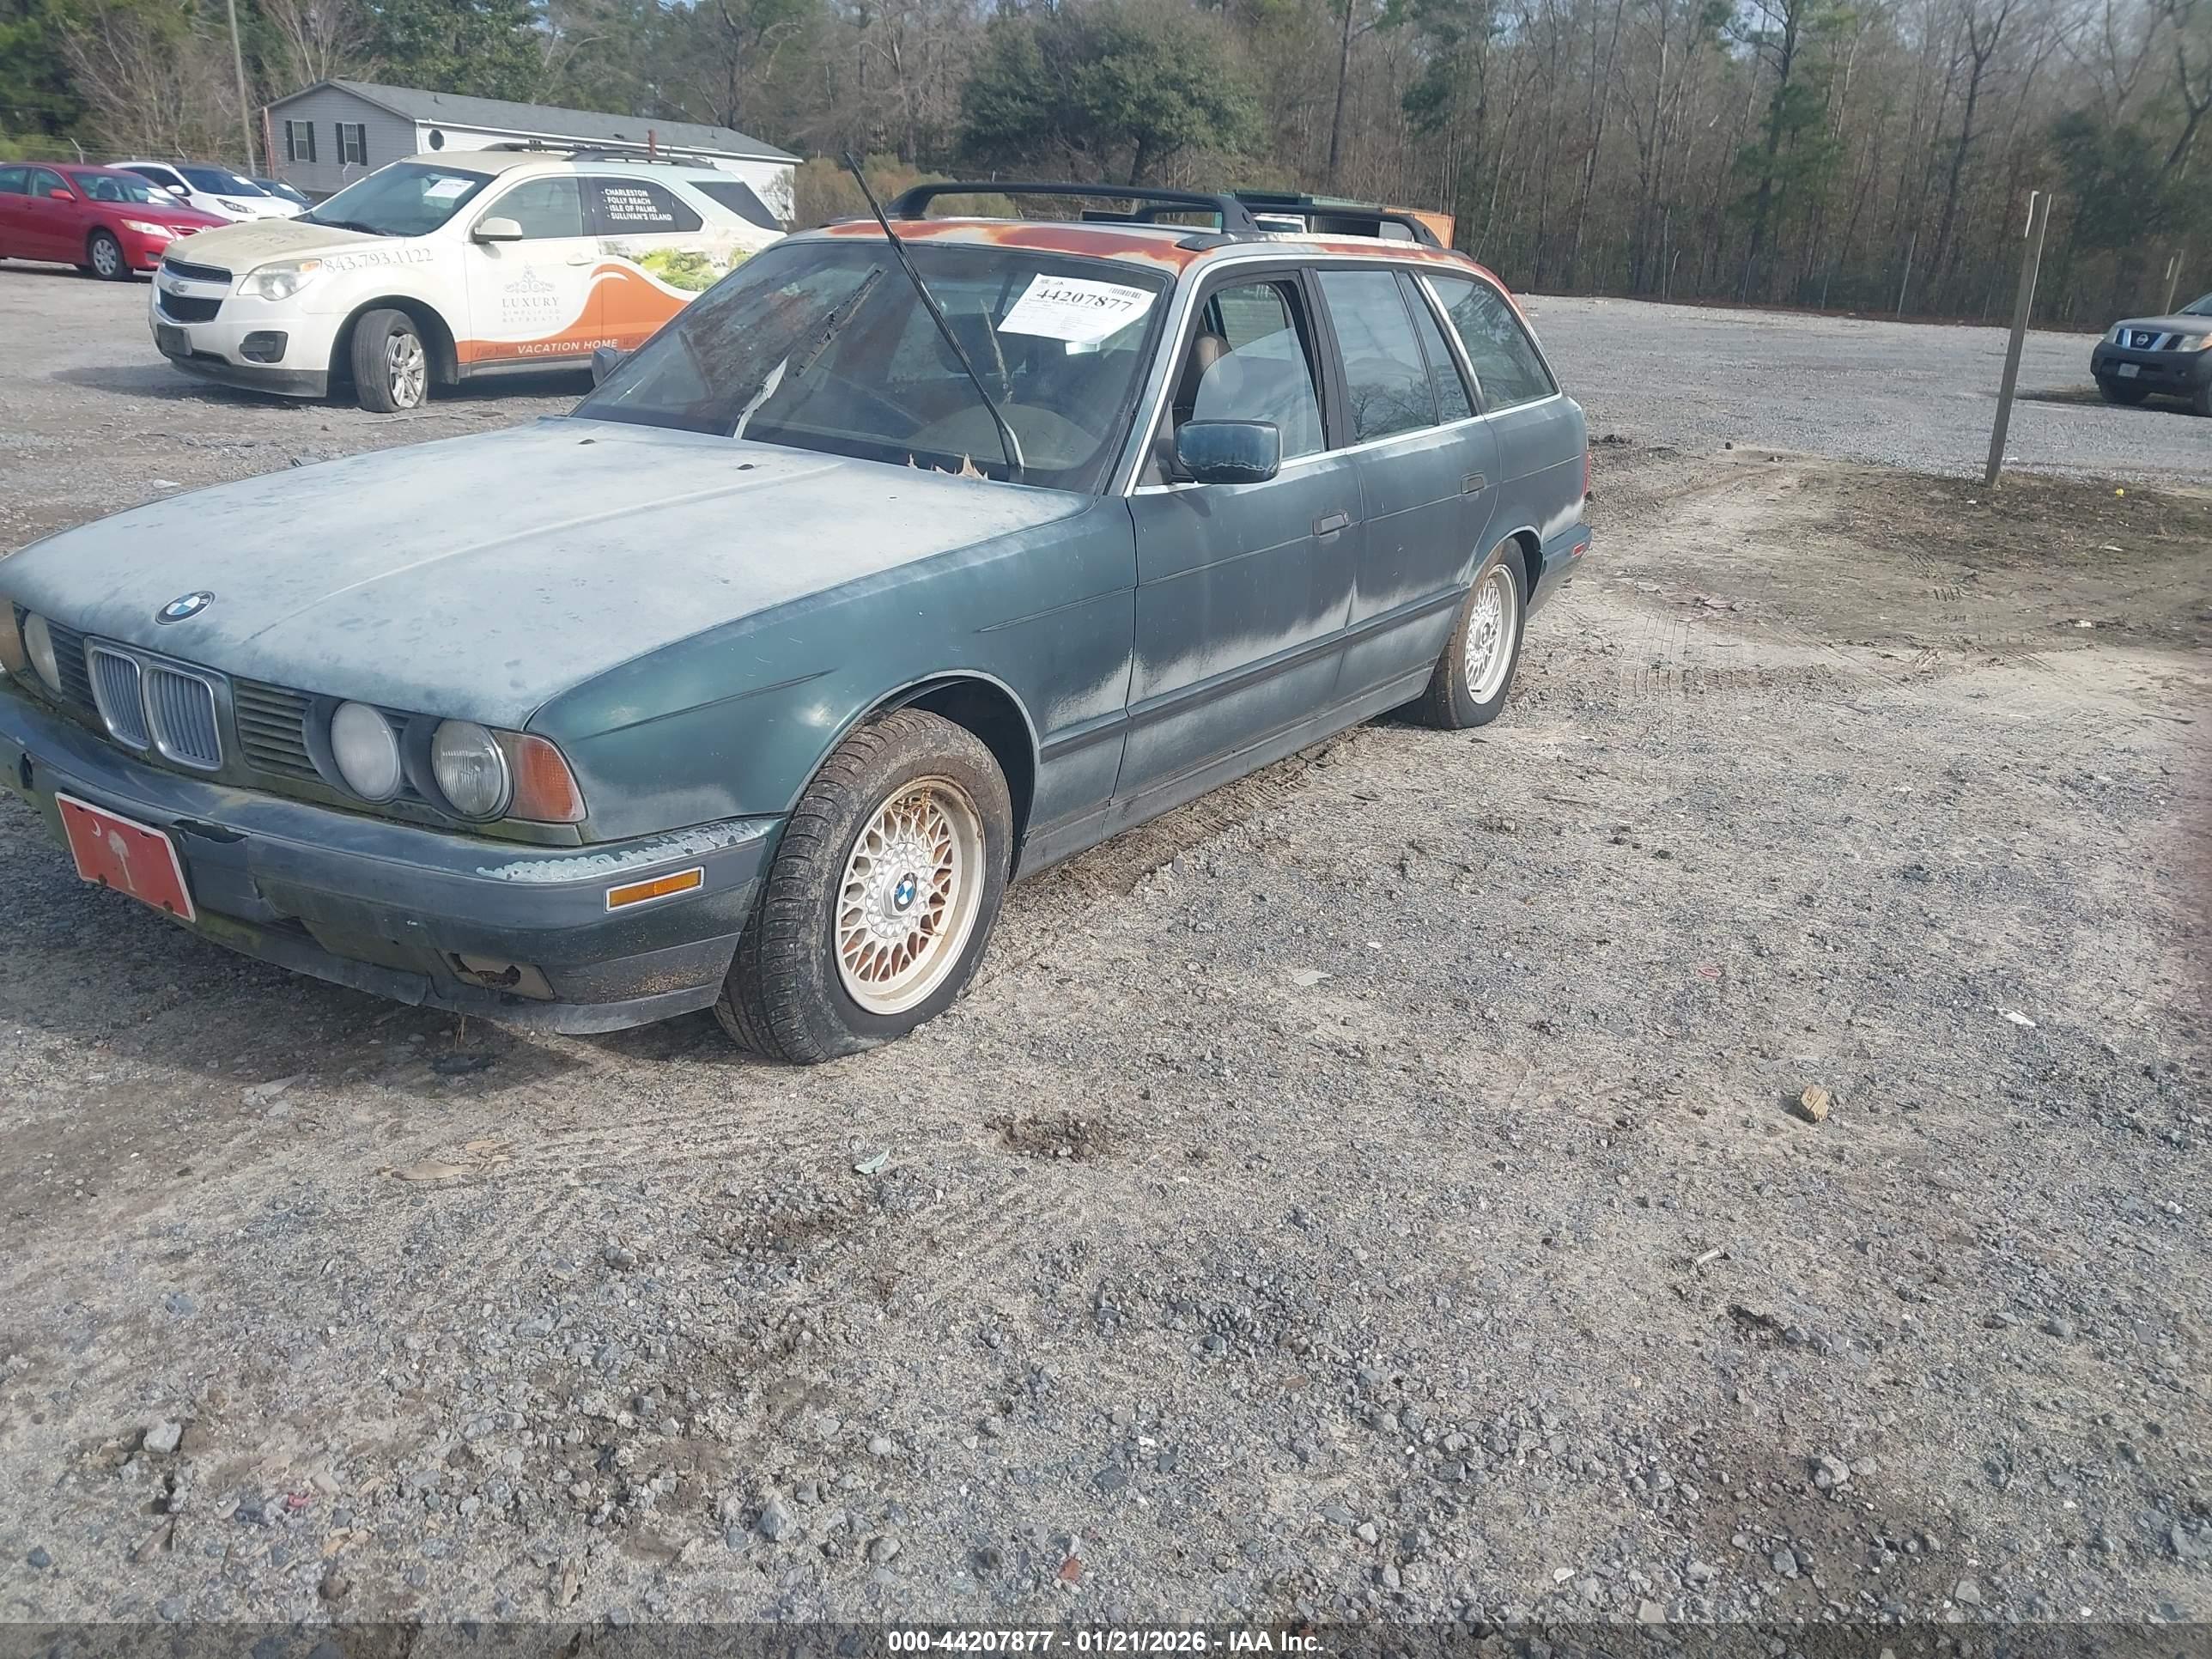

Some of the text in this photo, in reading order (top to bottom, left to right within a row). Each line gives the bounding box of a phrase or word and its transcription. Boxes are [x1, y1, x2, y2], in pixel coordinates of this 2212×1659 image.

[605, 188, 648, 197] CHARLESTON
[324, 247, 434, 274] 843.793.1122
[501, 295, 560, 308] LUXURY
[1036, 289, 1135, 312] 44207877
[517, 341, 580, 355] VACATION
[583, 338, 618, 350] HOME
